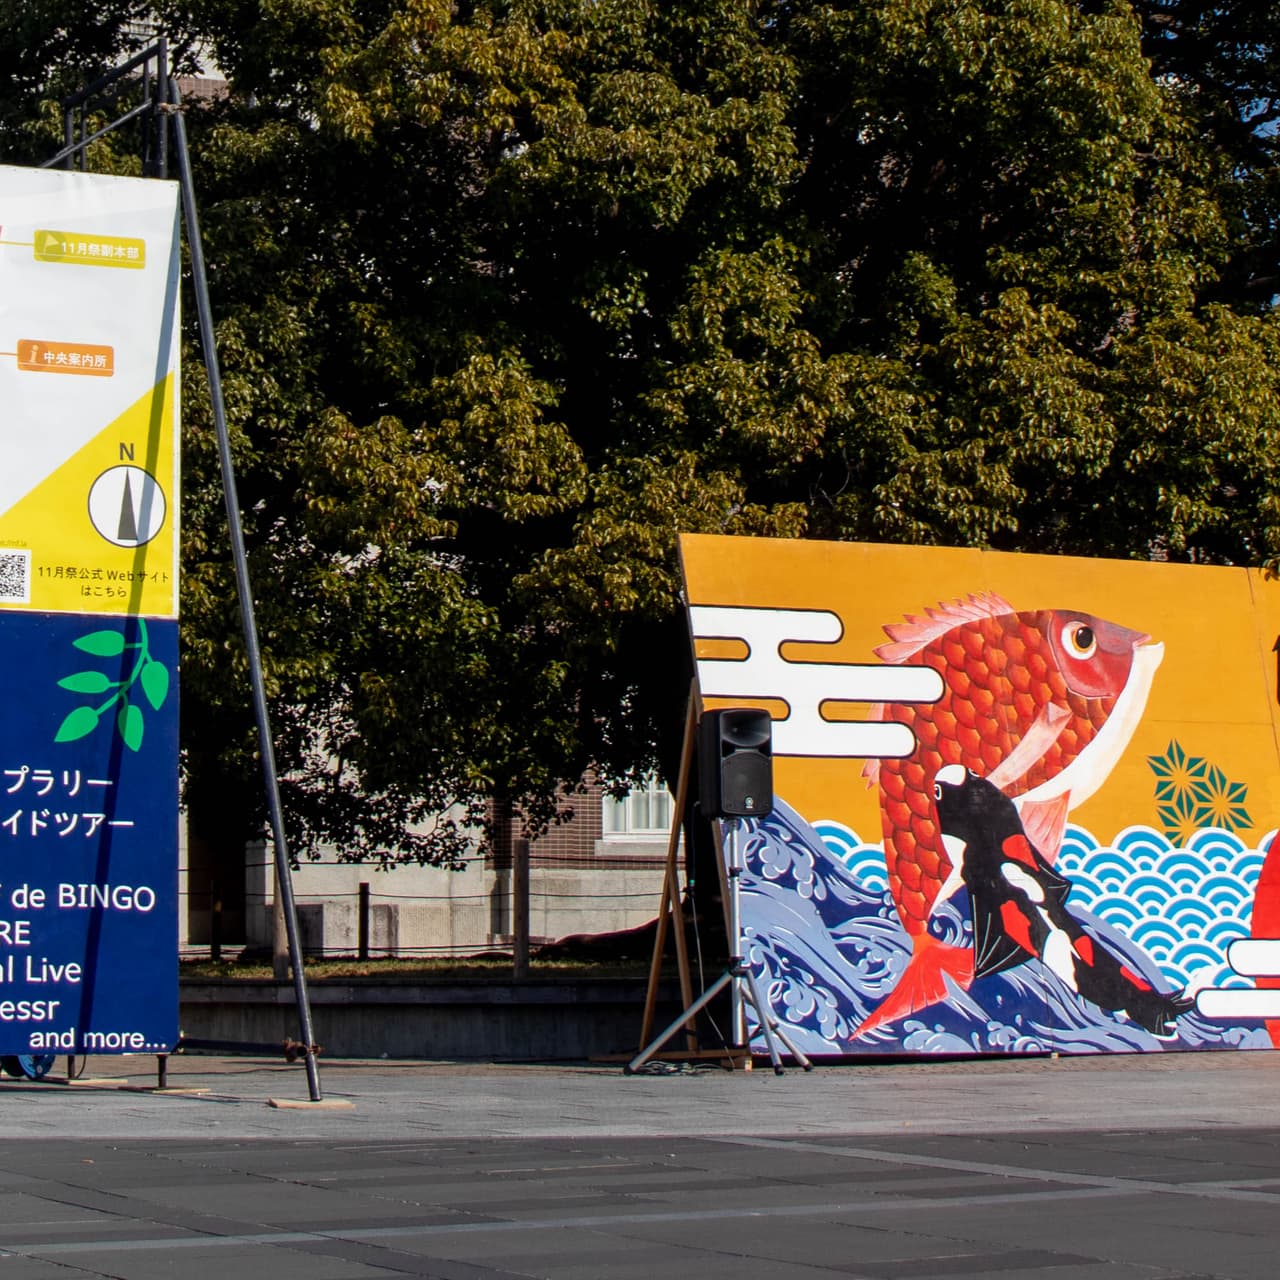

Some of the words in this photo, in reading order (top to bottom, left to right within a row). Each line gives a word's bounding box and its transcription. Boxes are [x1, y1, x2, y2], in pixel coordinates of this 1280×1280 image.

[61, 242, 140, 260] 11月祭副本部
[43, 351, 108, 368] 中央案内所
[119, 442, 135, 461] N
[81, 585, 128, 599] はこちら
[11, 883, 46, 909] de
[58, 884, 156, 912] BINGO
[26, 955, 82, 982] Live
[29, 1027, 75, 1049] and
[83, 1031, 167, 1049] more...
